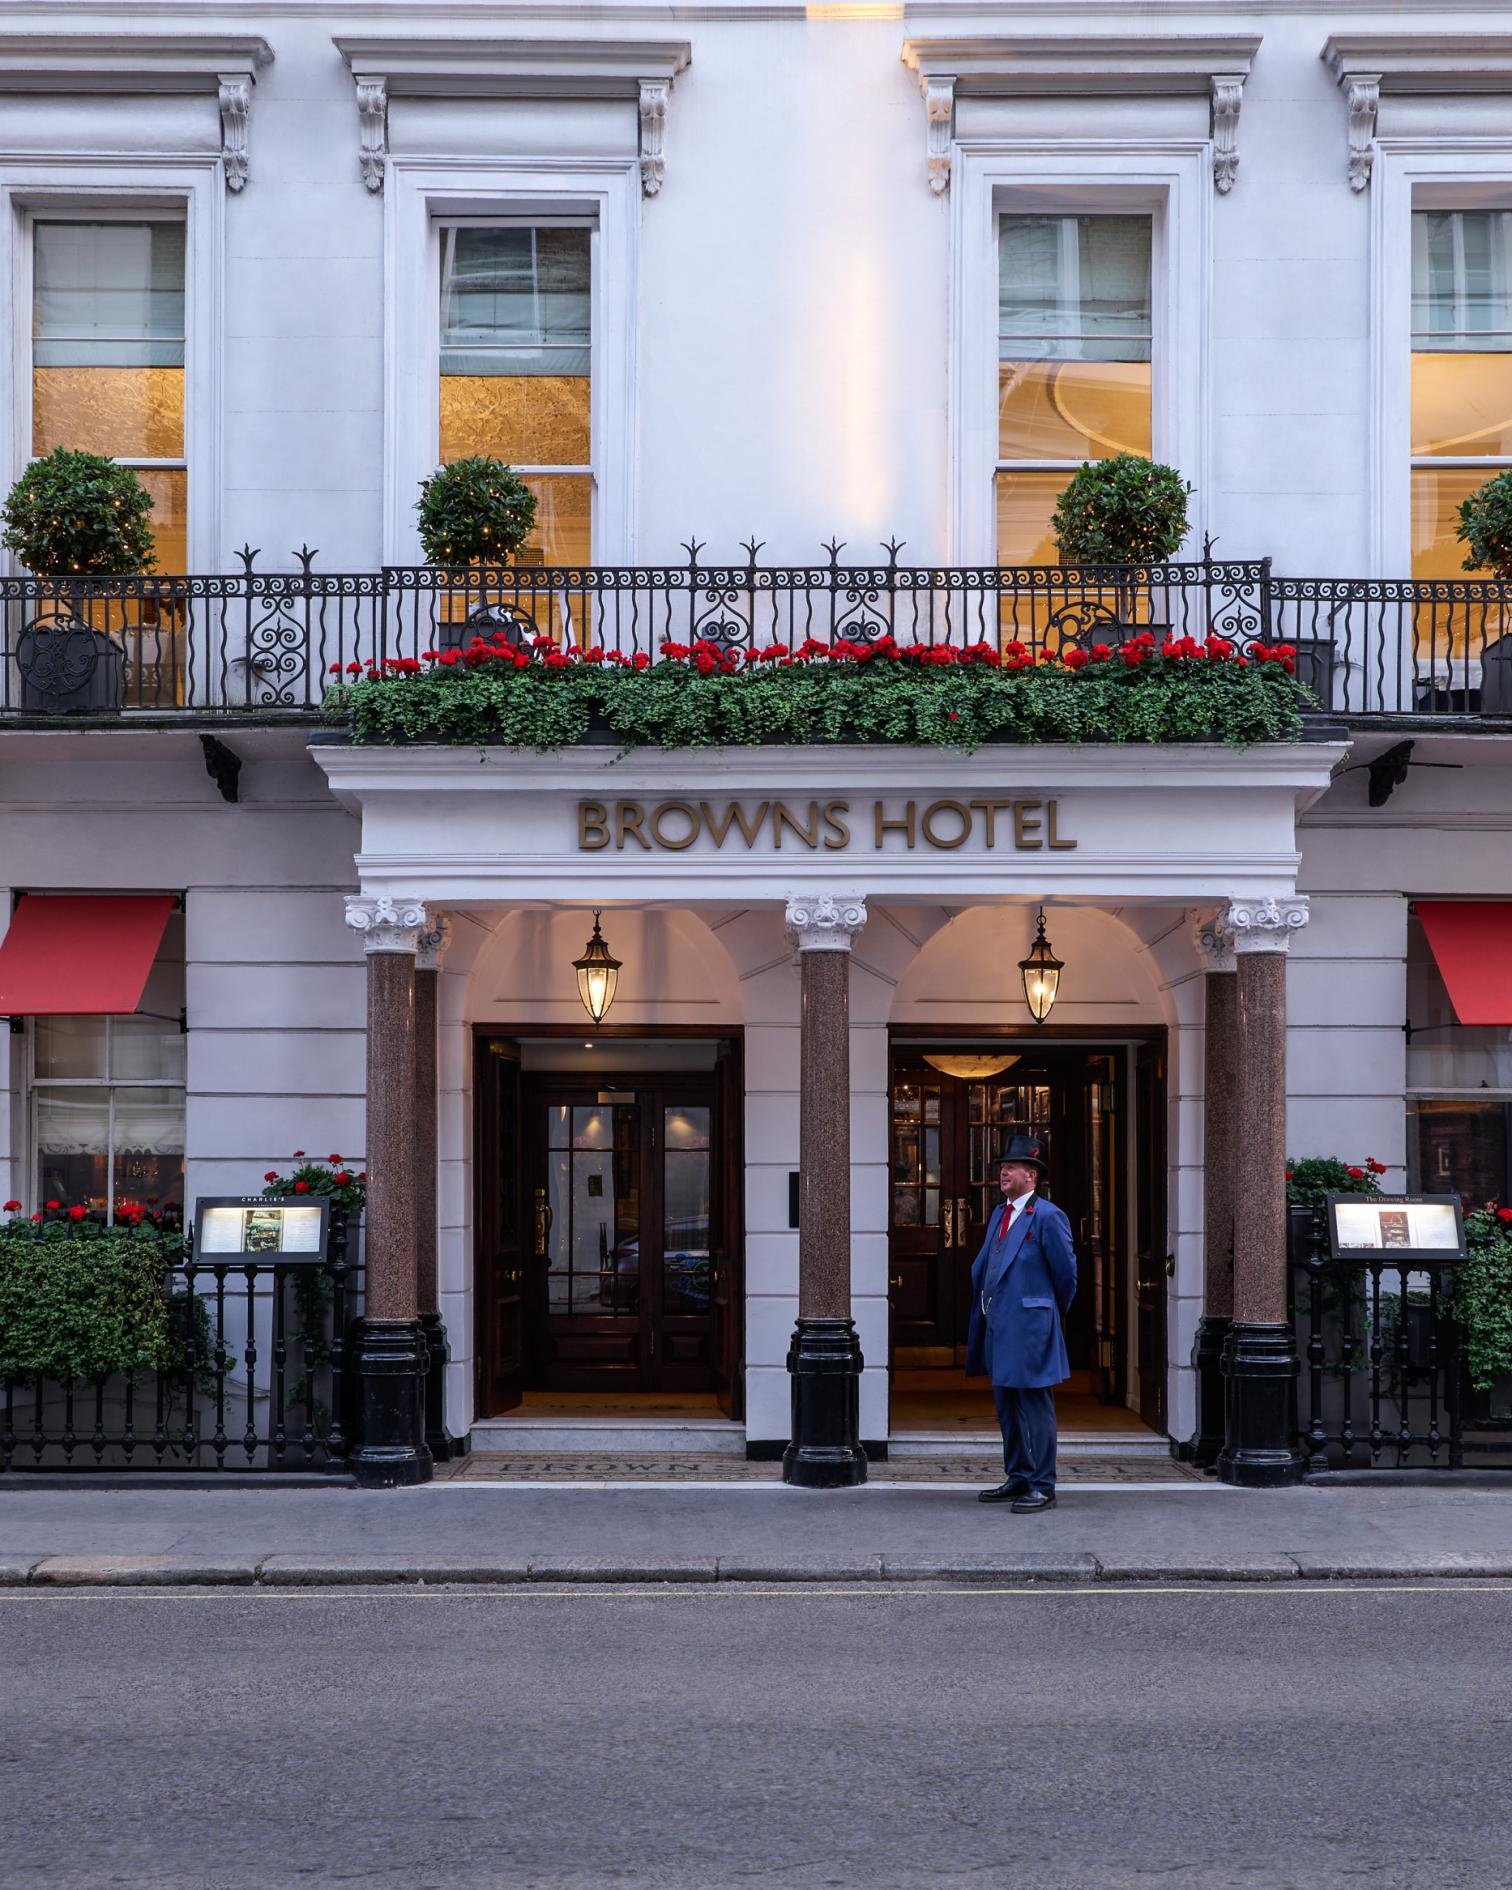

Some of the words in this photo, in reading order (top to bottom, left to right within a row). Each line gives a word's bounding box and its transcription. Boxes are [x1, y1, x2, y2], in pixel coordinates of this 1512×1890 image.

[577, 800, 850, 850] BROWNS
[874, 799, 1079, 849] HOTEL
[937, 1464, 1139, 1474] HOEL
